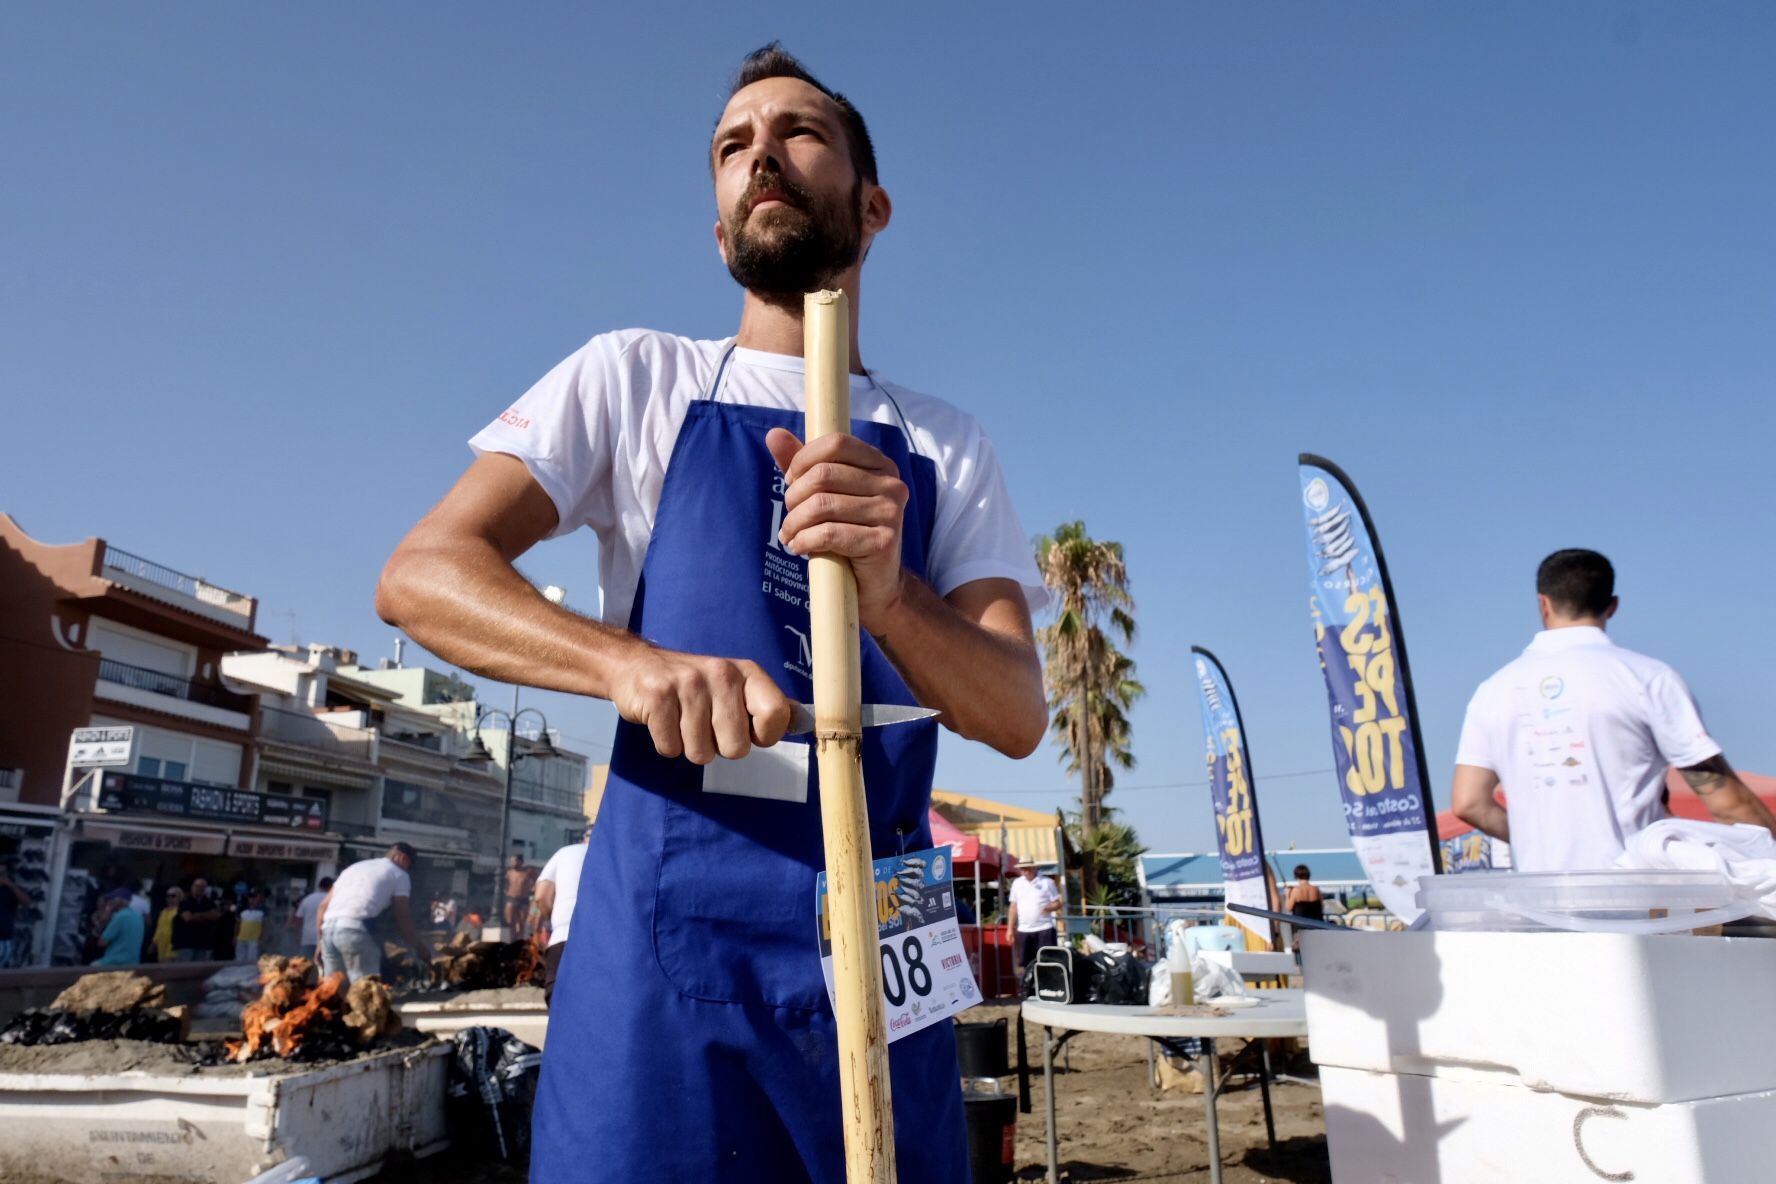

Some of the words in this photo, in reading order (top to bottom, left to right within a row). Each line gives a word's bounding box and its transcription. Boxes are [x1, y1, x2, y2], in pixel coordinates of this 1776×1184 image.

[764, 560, 803, 581] AUTÓCTONOS
[765, 551, 800, 571] PRODUCTOS
[763, 568, 772, 578] DE
[773, 571, 780, 581] LA
[762, 581, 772, 593] El
[774, 586, 802, 607] sabor
[881, 936, 933, 1007] 08
[941, 953, 962, 970] VICTORIA
